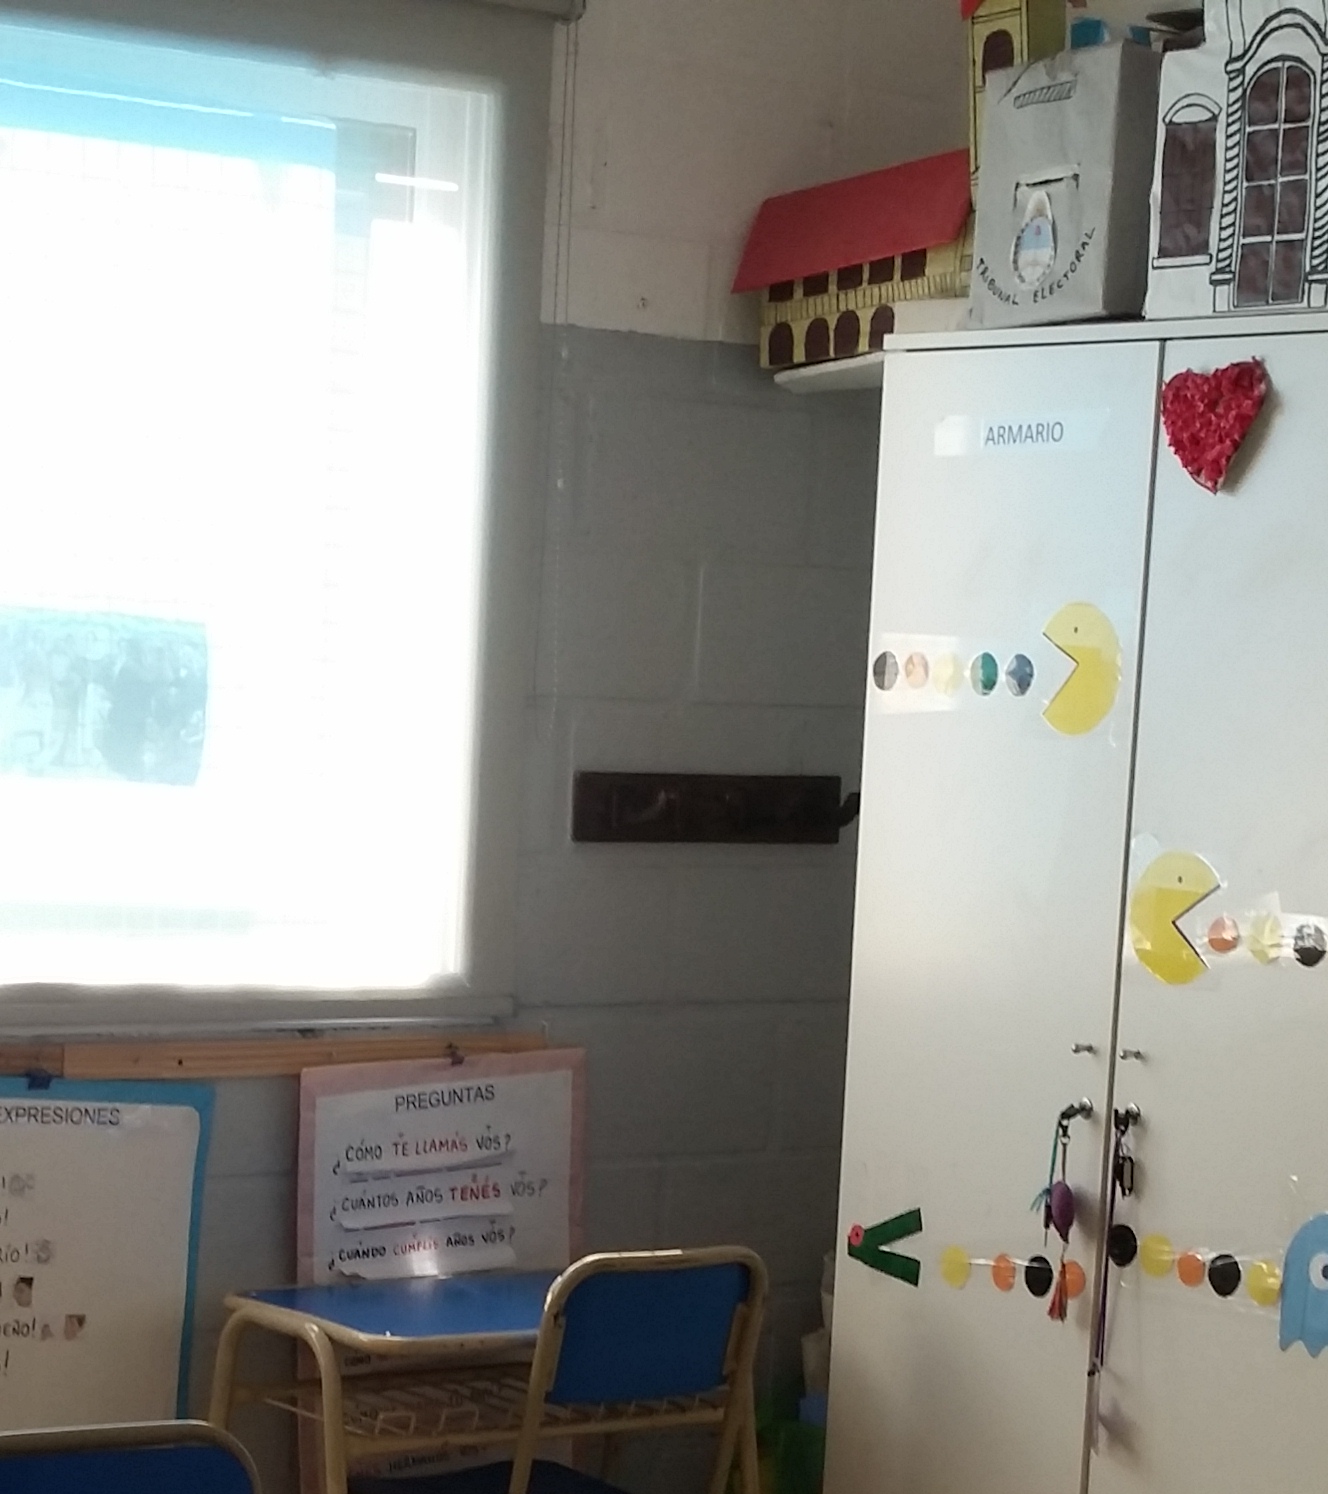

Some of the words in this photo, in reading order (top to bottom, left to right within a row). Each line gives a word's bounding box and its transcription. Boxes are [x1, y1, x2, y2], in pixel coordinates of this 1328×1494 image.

[1033, 227, 1096, 304] ELECTORAL
[983, 420, 1065, 447] ARMARIO
[394, 1084, 496, 1113] PREGUNTAS
